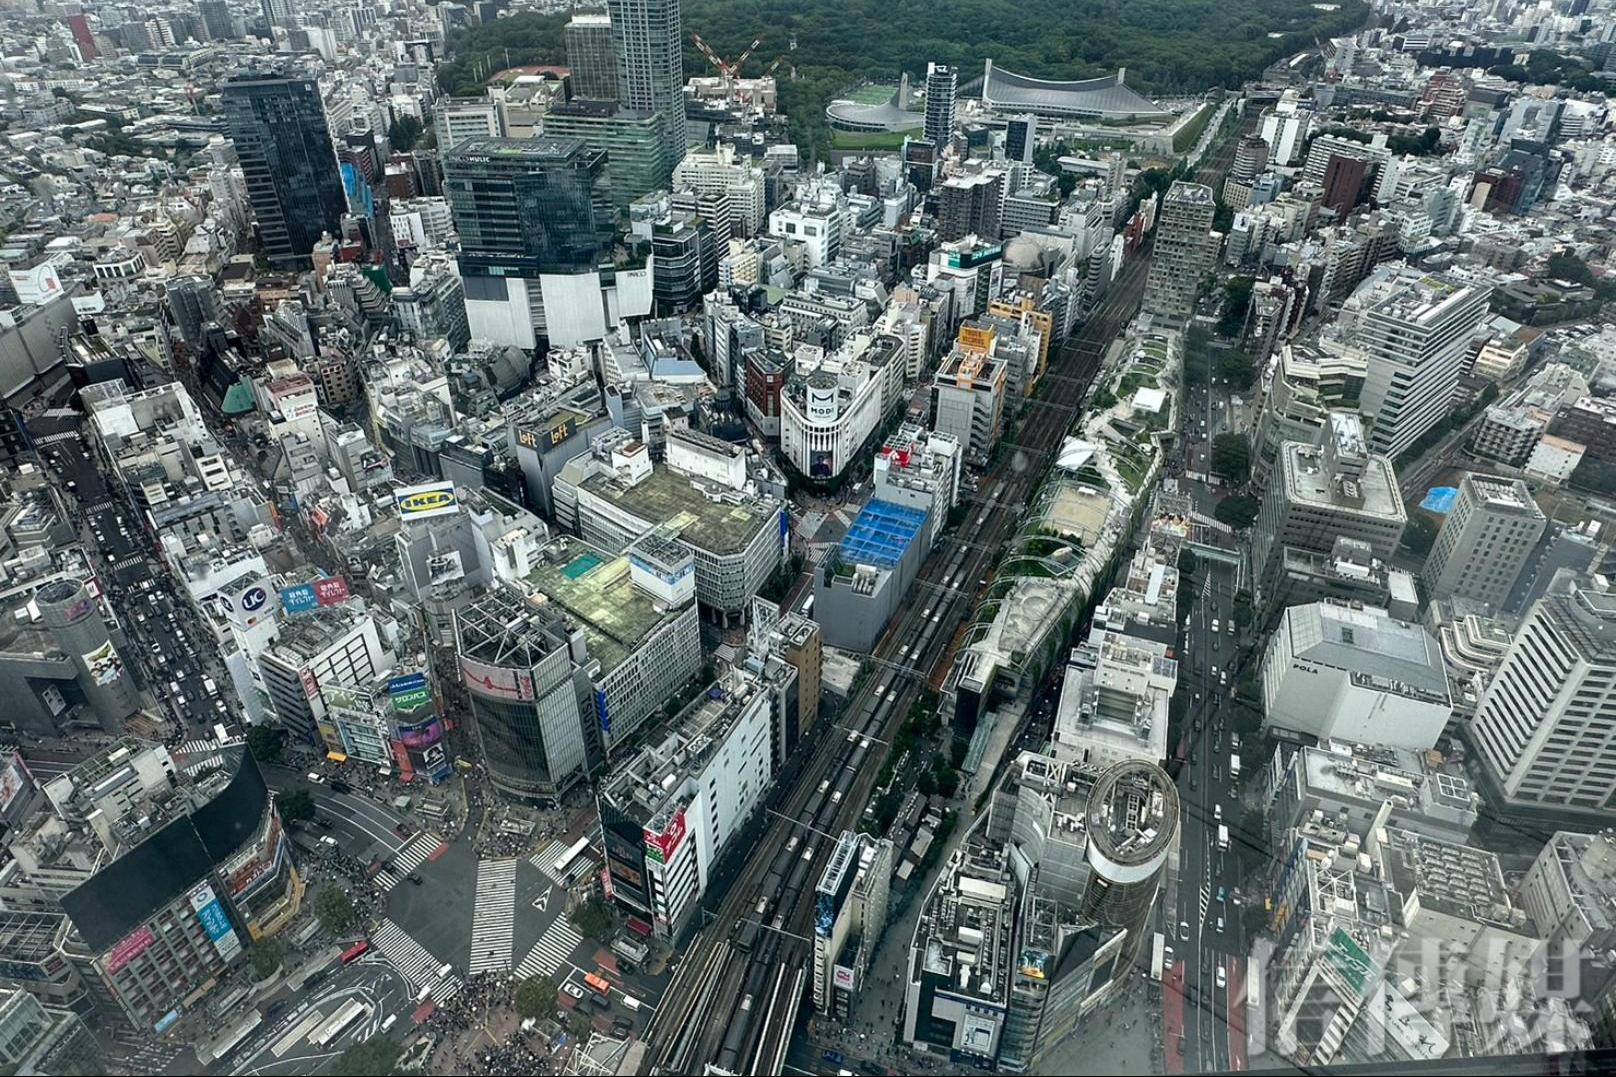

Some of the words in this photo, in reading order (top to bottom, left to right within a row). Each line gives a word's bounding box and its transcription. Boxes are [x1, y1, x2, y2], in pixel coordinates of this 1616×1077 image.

[811, 407, 835, 415] MODI
[404, 493, 451, 508] IKEA
[244, 590, 266, 609] UC
[1293, 663, 1318, 675] POLA
[580, 692, 599, 757] TSUTAYA
[1327, 941, 1376, 981] エイブル
